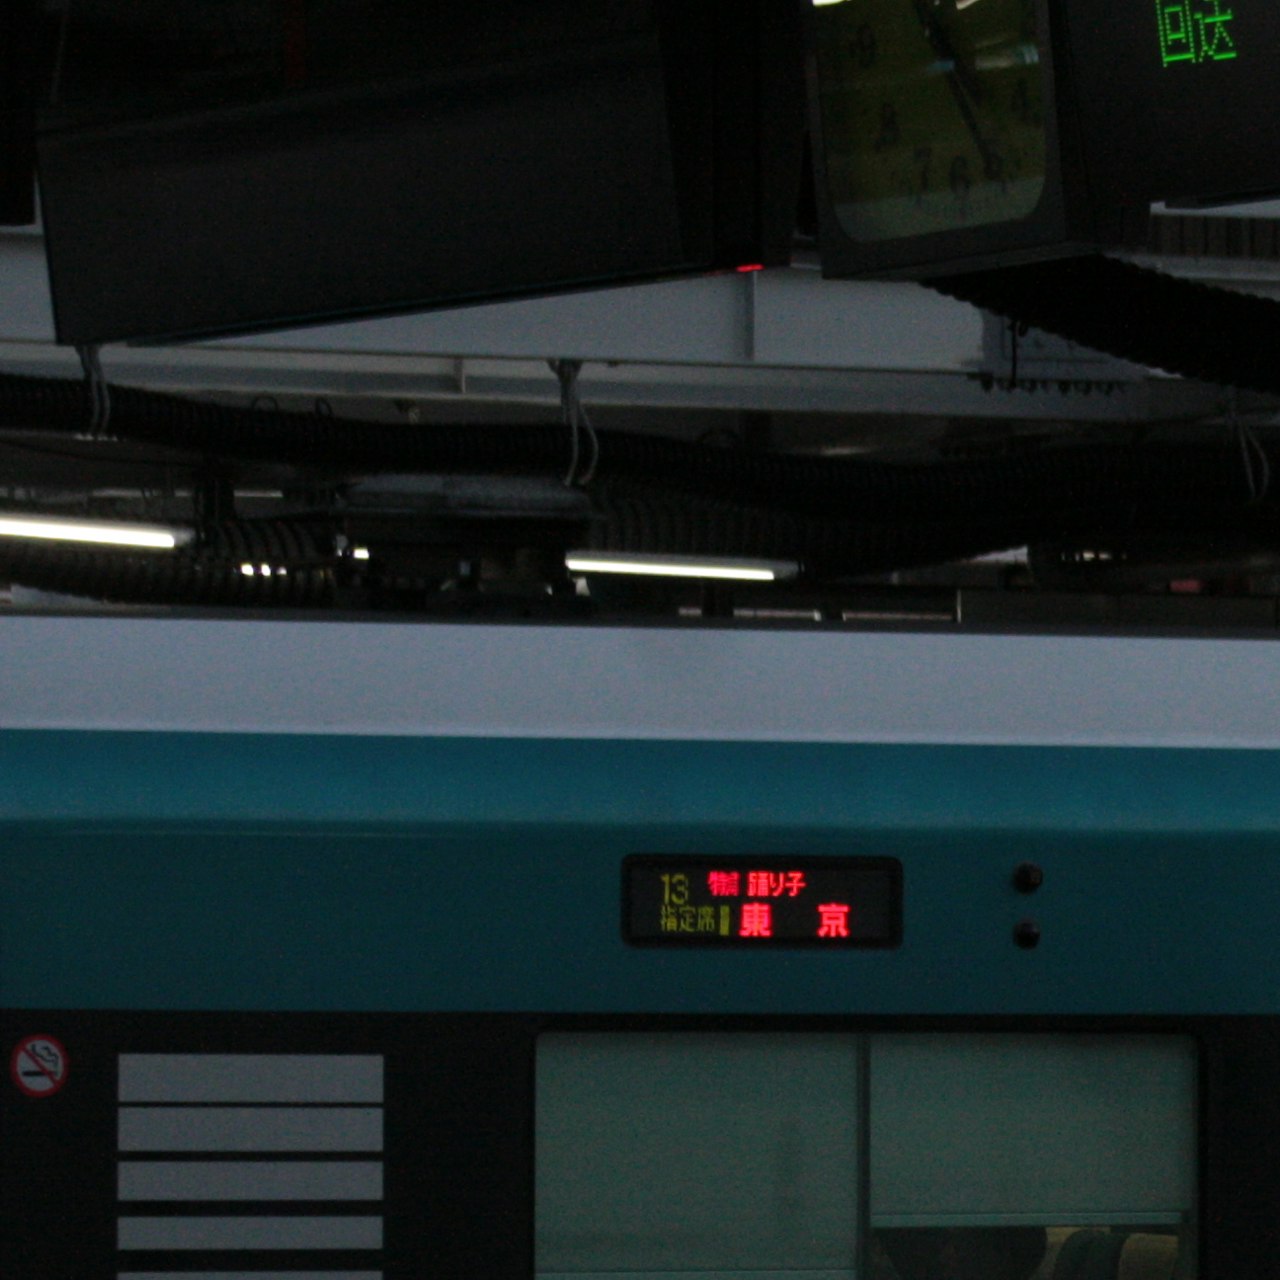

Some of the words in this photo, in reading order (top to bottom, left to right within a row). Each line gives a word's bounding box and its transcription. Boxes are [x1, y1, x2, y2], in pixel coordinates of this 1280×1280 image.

[1155, 0, 1237, 67] 回送
[661, 873, 689, 904] 13
[747, 870, 806, 897] 踊り子
